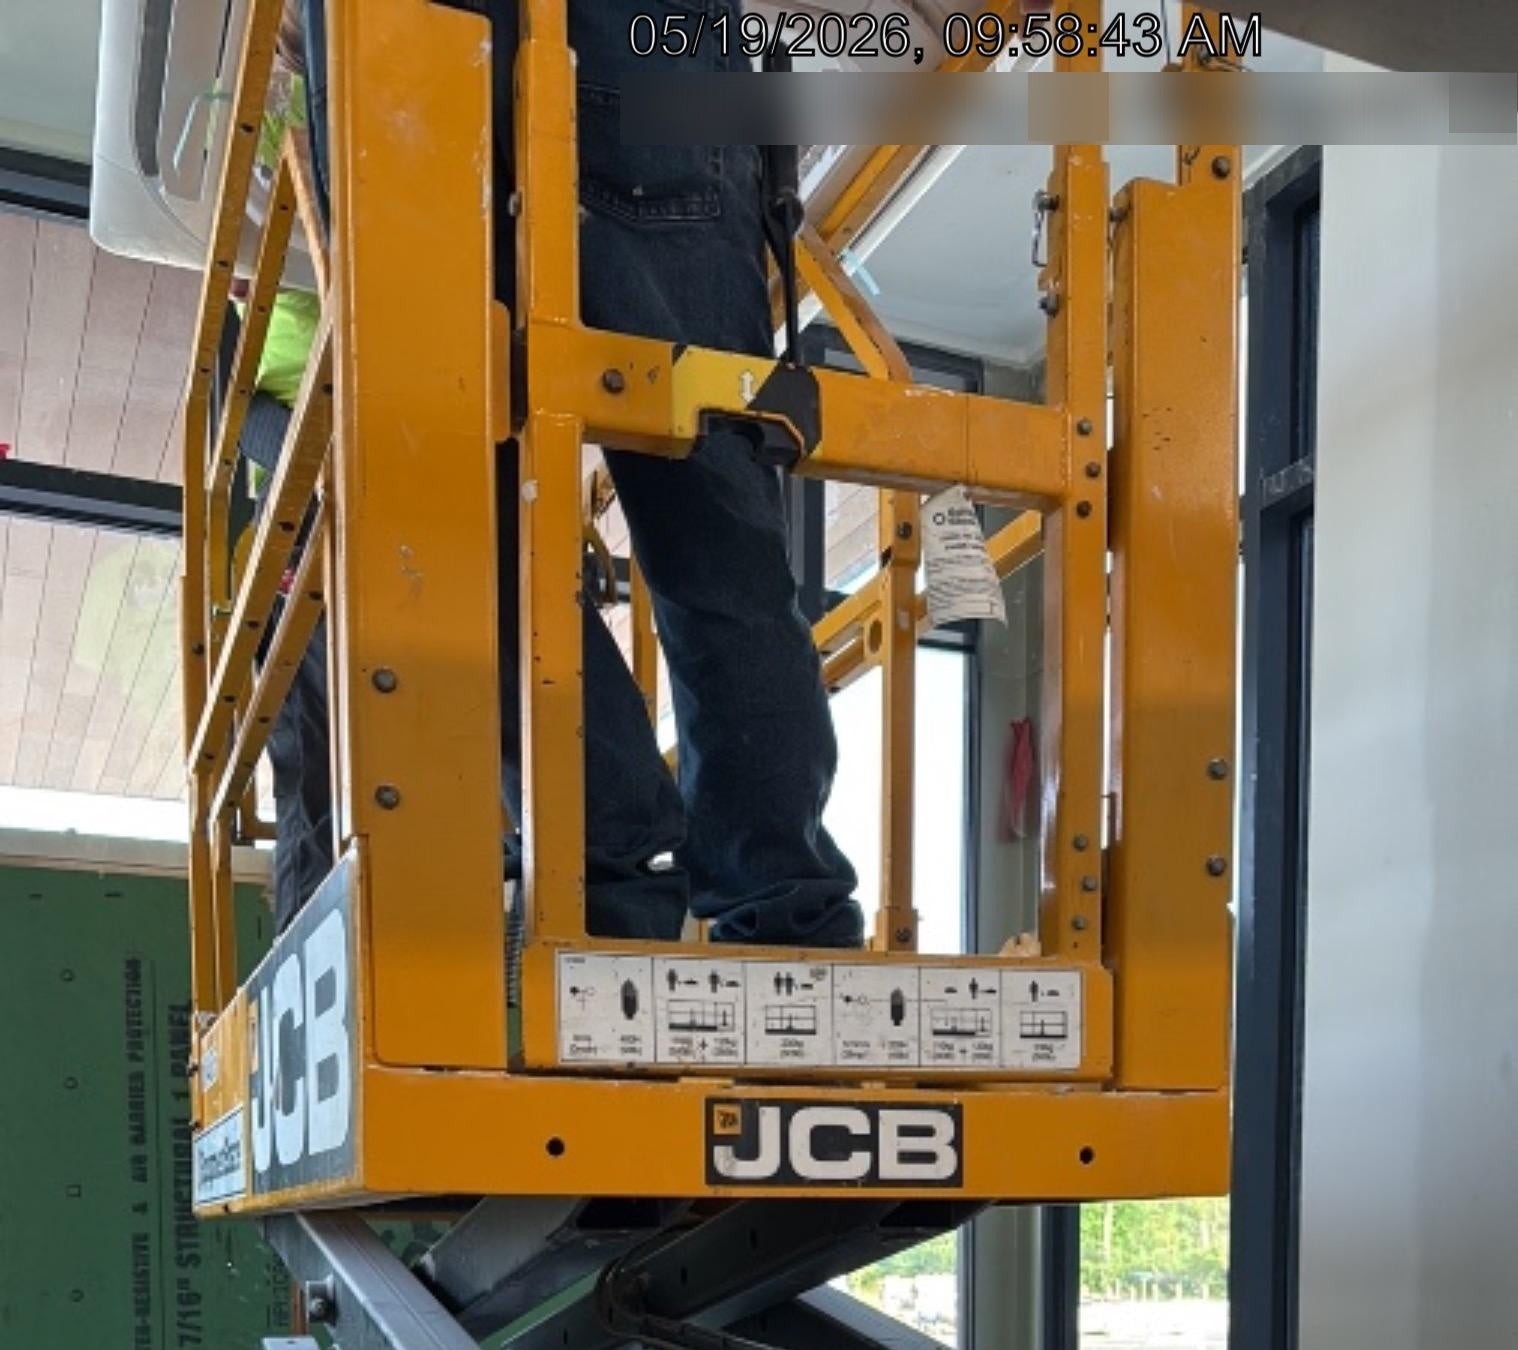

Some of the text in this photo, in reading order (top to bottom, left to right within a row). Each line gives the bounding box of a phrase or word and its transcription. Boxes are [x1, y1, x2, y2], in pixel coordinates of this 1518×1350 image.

[124, 958, 144, 1063] PROTECTION
[168, 1000, 192, 1078] PANEL
[252, 908, 350, 1173] JCB
[127, 1071, 147, 1146] BARRIER
[713, 1105, 958, 1180] JCB
[128, 1154, 148, 1184] AIR
[131, 1201, 149, 1215] &
